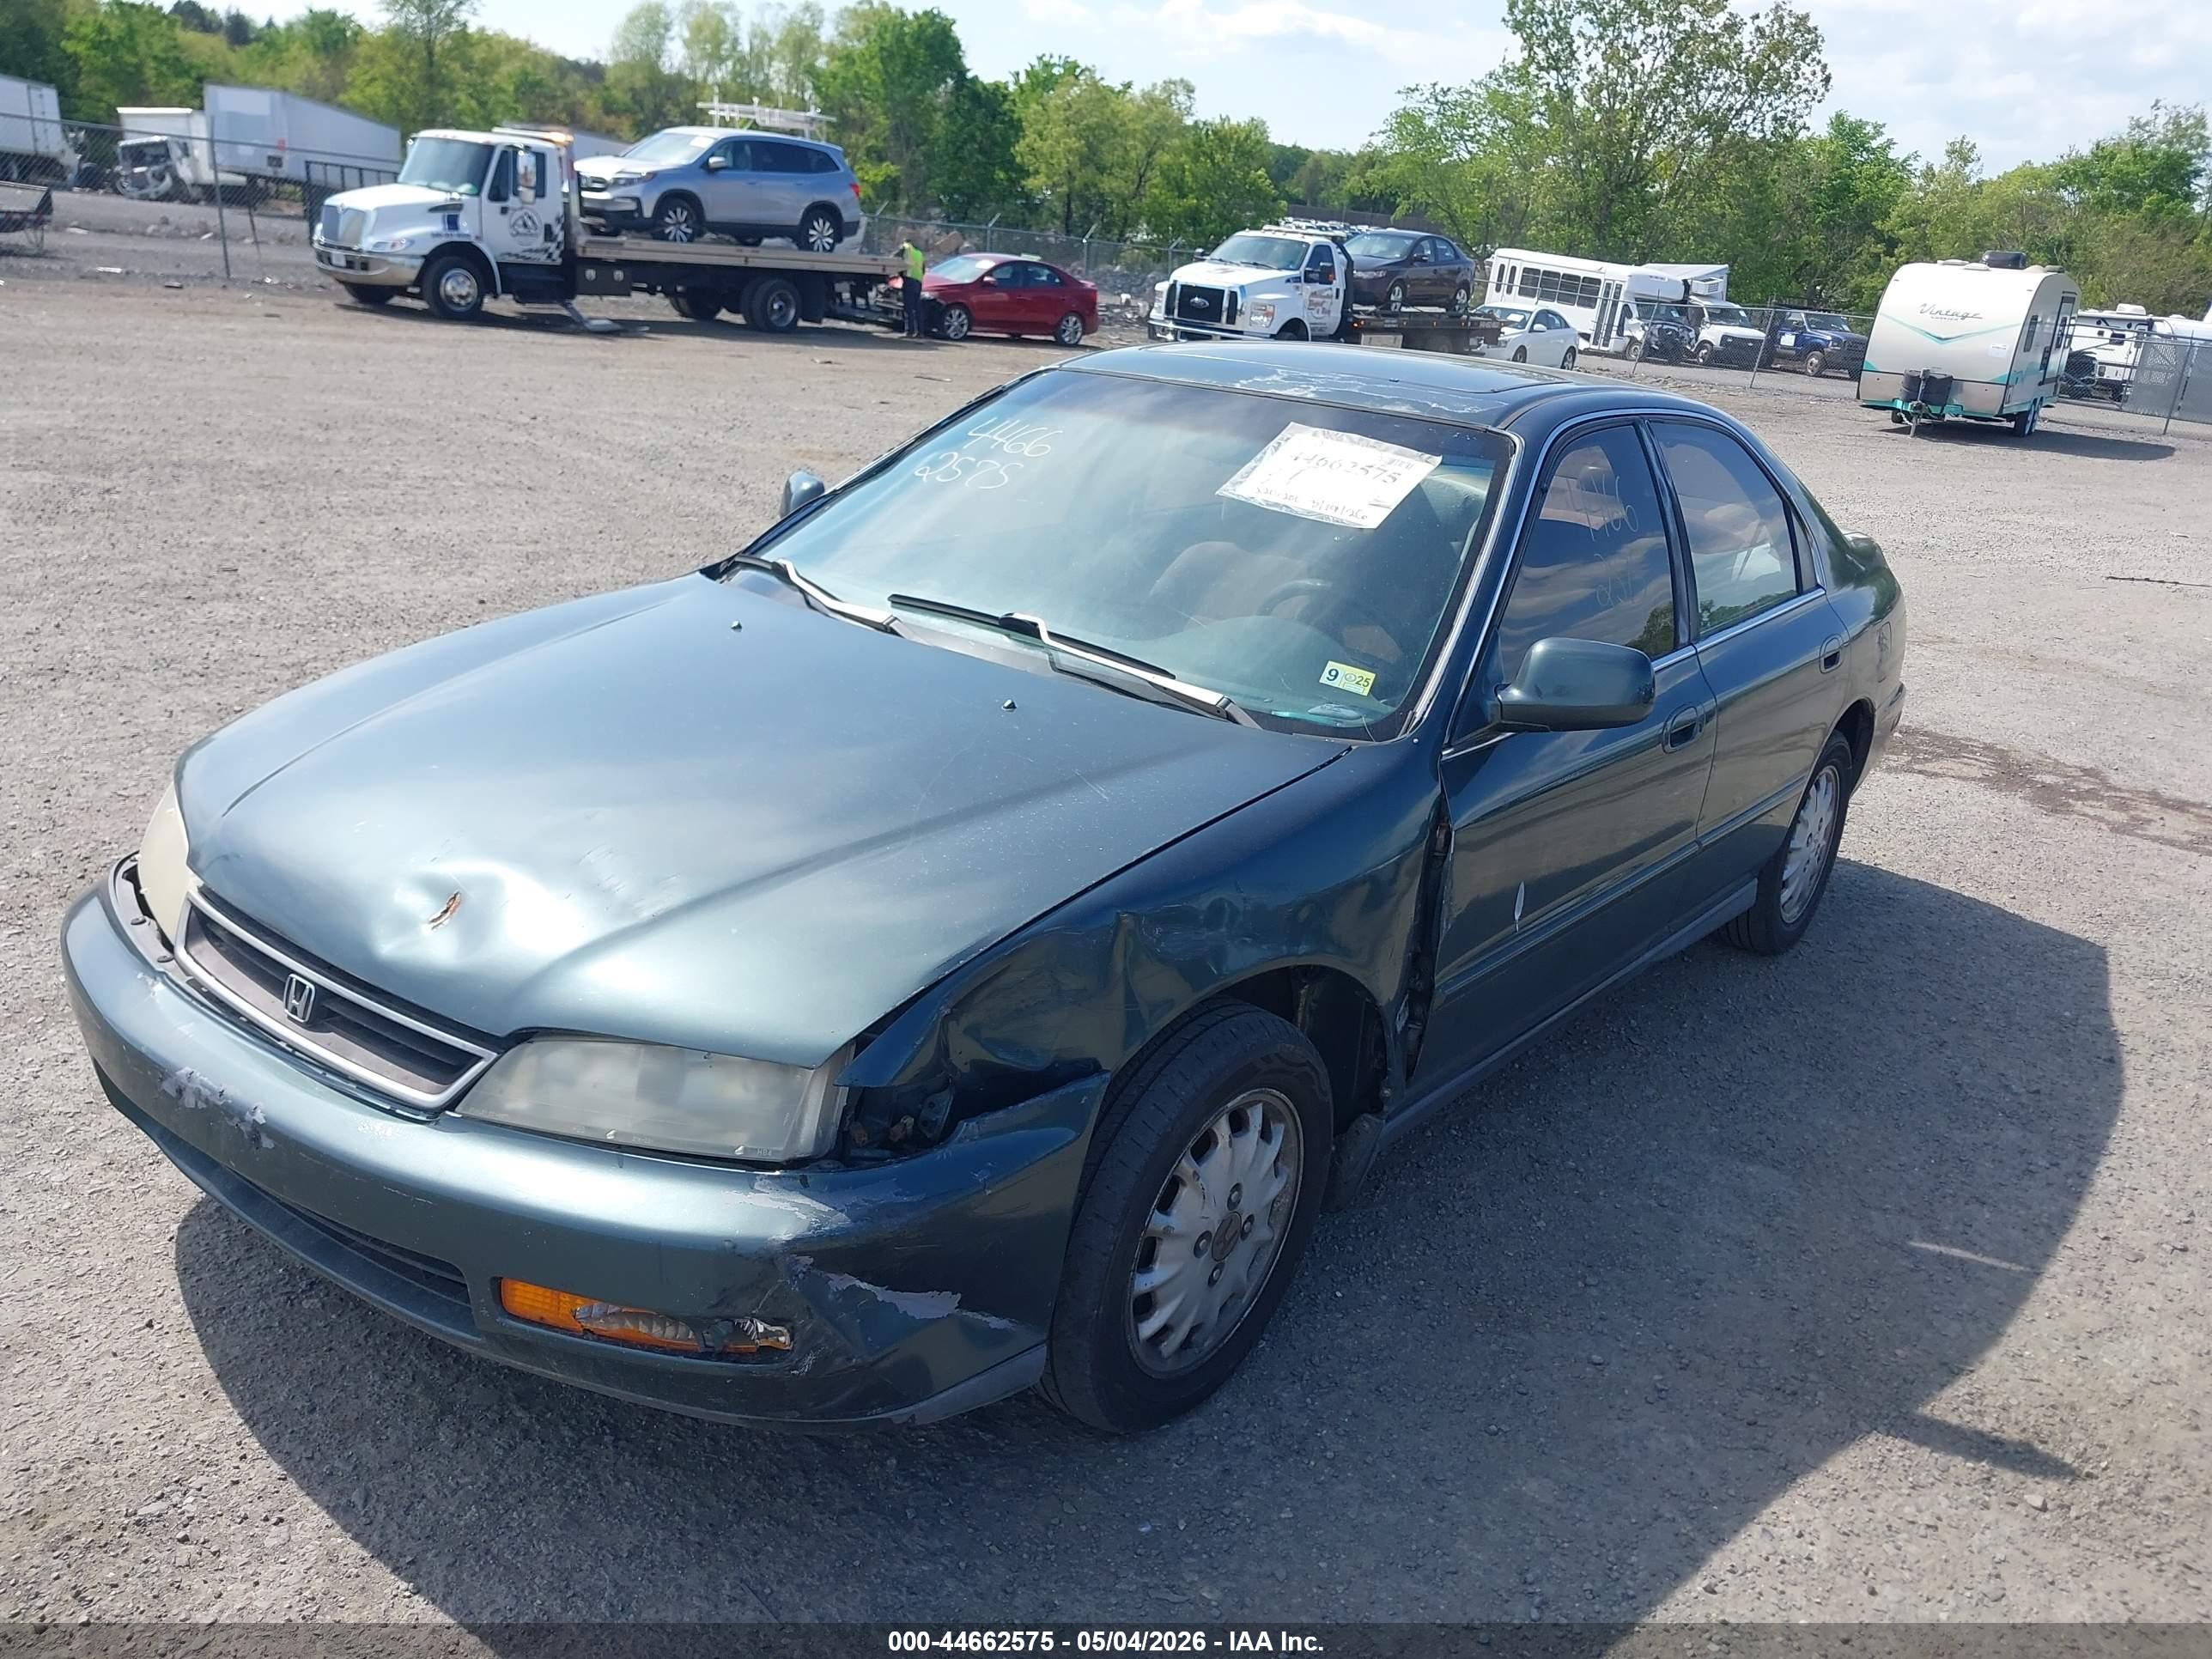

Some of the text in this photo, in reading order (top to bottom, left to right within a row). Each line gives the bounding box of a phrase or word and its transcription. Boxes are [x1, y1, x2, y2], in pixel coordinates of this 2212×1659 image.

[1919, 302, 1984, 320] Vintage
[963, 417, 1063, 457] 4466
[1326, 668, 1371, 688] 9 25
